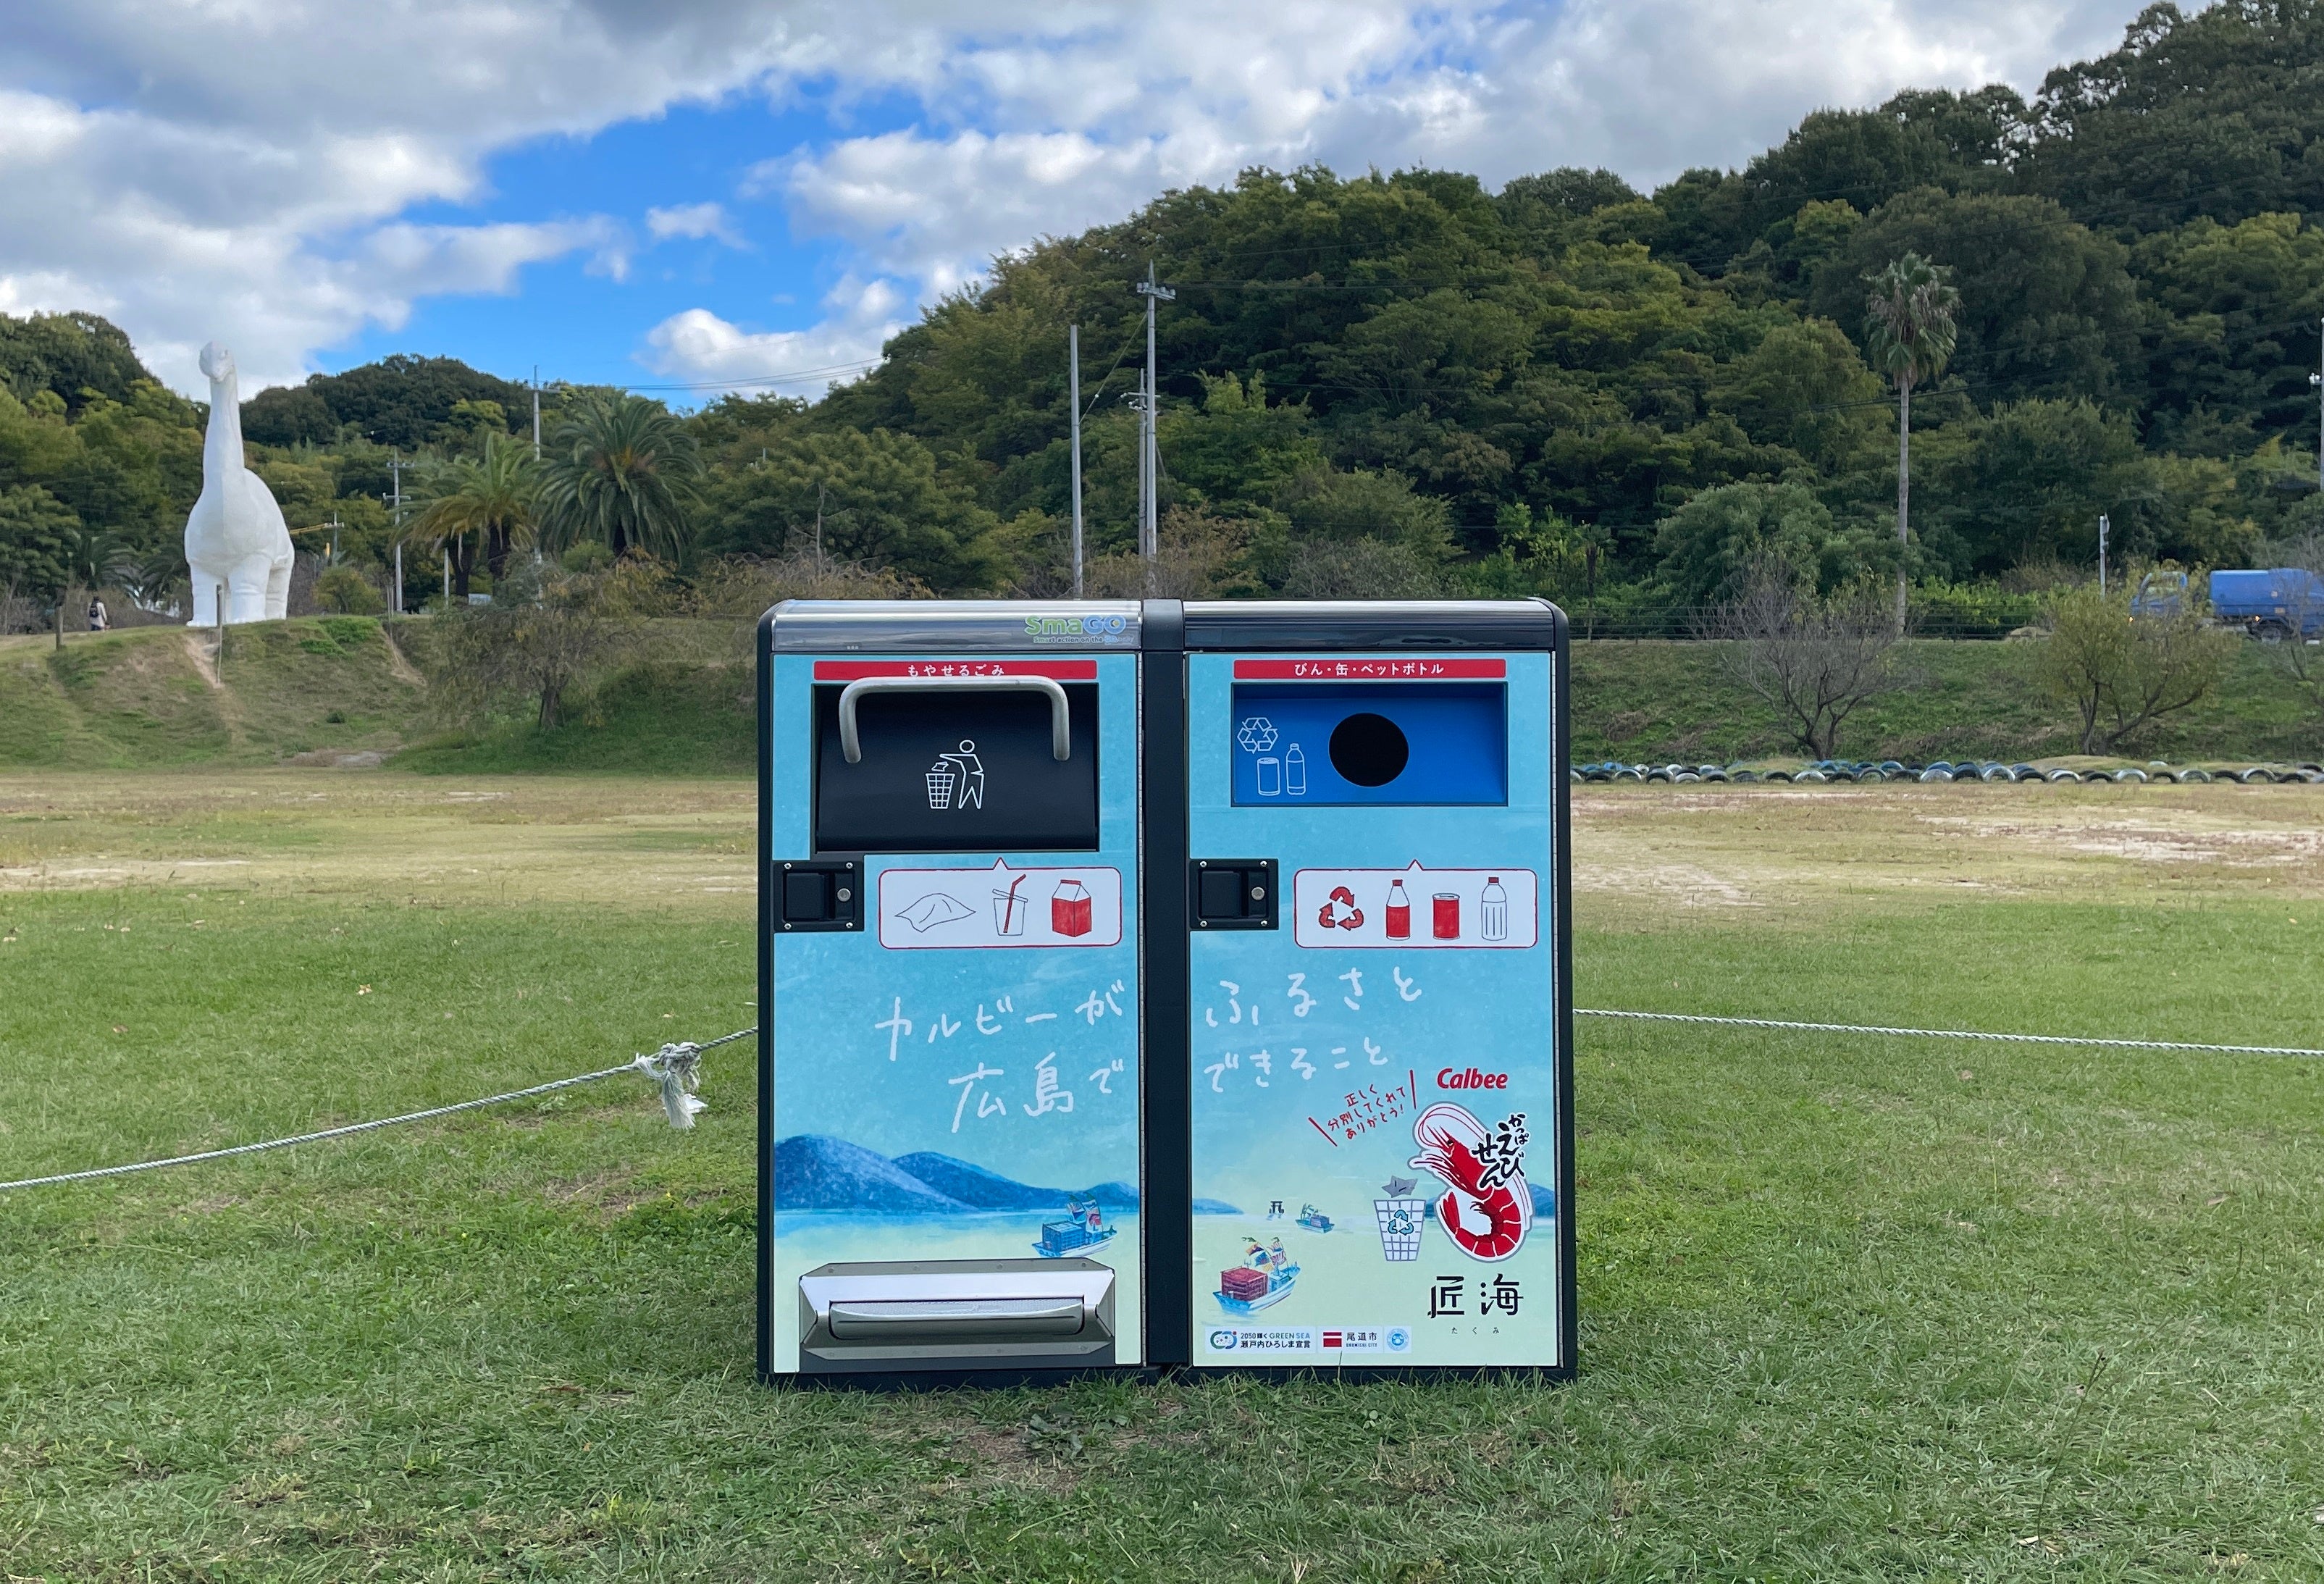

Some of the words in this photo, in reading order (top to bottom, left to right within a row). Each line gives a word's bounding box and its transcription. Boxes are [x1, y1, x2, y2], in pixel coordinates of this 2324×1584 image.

[1025, 615, 1126, 634] SmaGO
[1033, 635, 1055, 644] Smart
[1057, 635, 1079, 644] action
[1091, 634, 1103, 643] the
[907, 664, 1004, 676] もやせるごみ
[1295, 662, 1444, 676] びん・缶・ペットボトル
[1206, 966, 1422, 1027] ふるさと
[875, 979, 1125, 1062] カルビーが
[1204, 1037, 1388, 1093] できること
[1437, 1068, 1509, 1089] Calbee
[948, 1052, 1124, 1133] 広島で
[1328, 1086, 1406, 1131] 分別してくれて
[1344, 1084, 1377, 1107] 正しく
[1508, 1113, 1530, 1145] かっぱ
[1471, 1133, 1506, 1189] せん
[1427, 1273, 1524, 1318] 匠海
[1346, 1332, 1377, 1341] 尾道市
